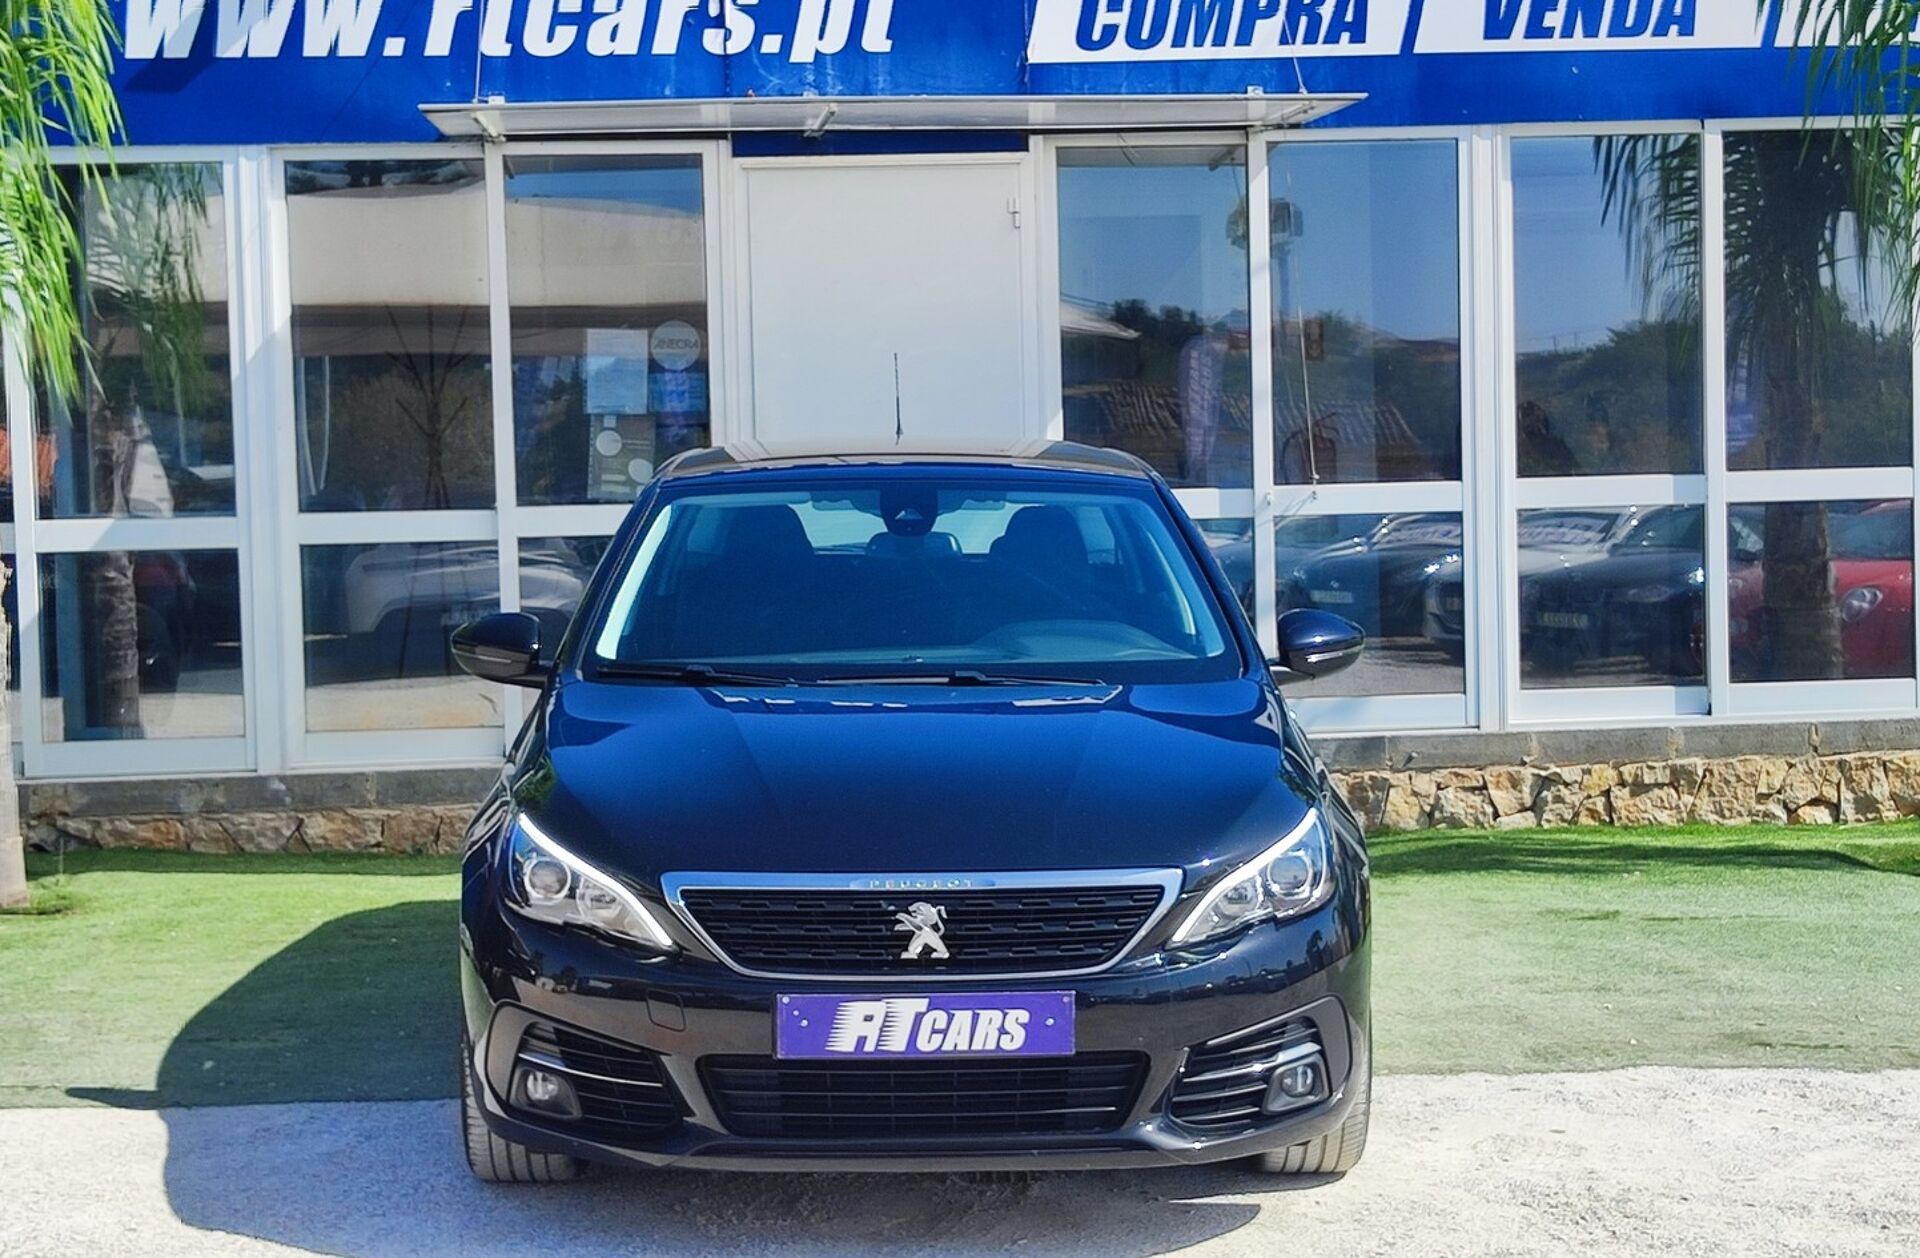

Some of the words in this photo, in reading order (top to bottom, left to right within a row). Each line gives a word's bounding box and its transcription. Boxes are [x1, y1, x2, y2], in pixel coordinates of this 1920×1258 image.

[1075, 0, 1367, 52] COMPRA
[1482, 0, 1698, 40] VENDA
[869, 879, 973, 889] PEUGEOT
